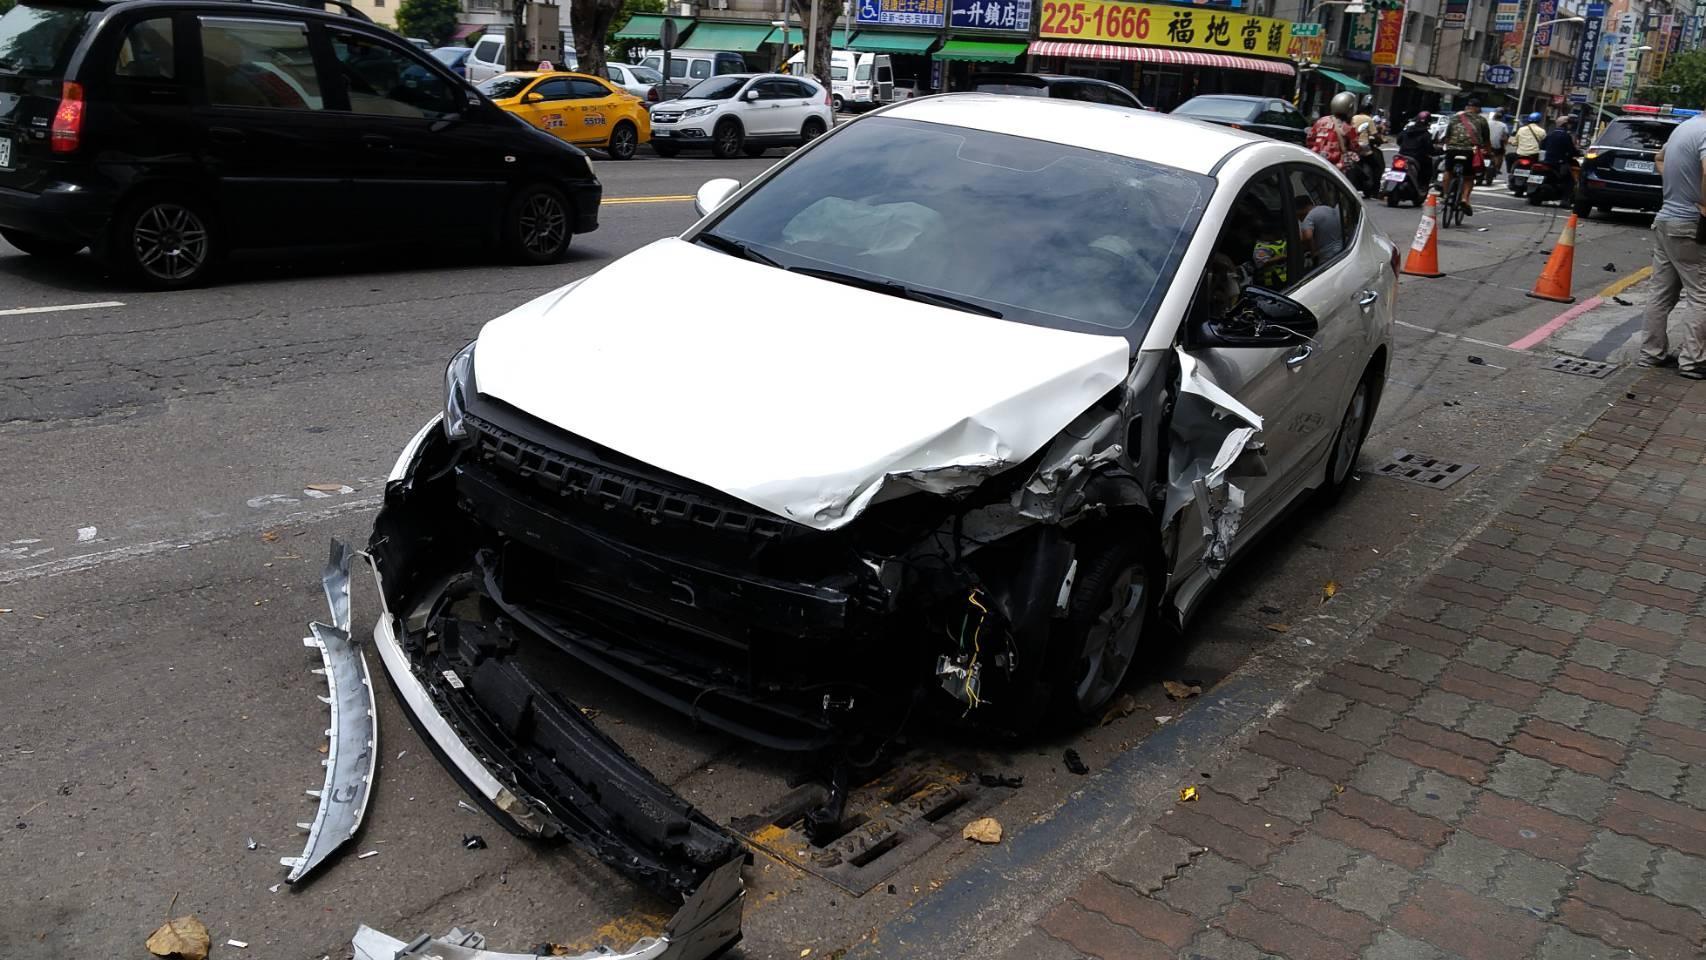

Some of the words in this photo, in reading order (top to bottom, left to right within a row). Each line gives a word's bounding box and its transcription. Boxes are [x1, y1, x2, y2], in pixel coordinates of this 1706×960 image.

[953, 1, 1016, 26] 一升鎖店
[1041, 2, 1151, 39] 225-1666
